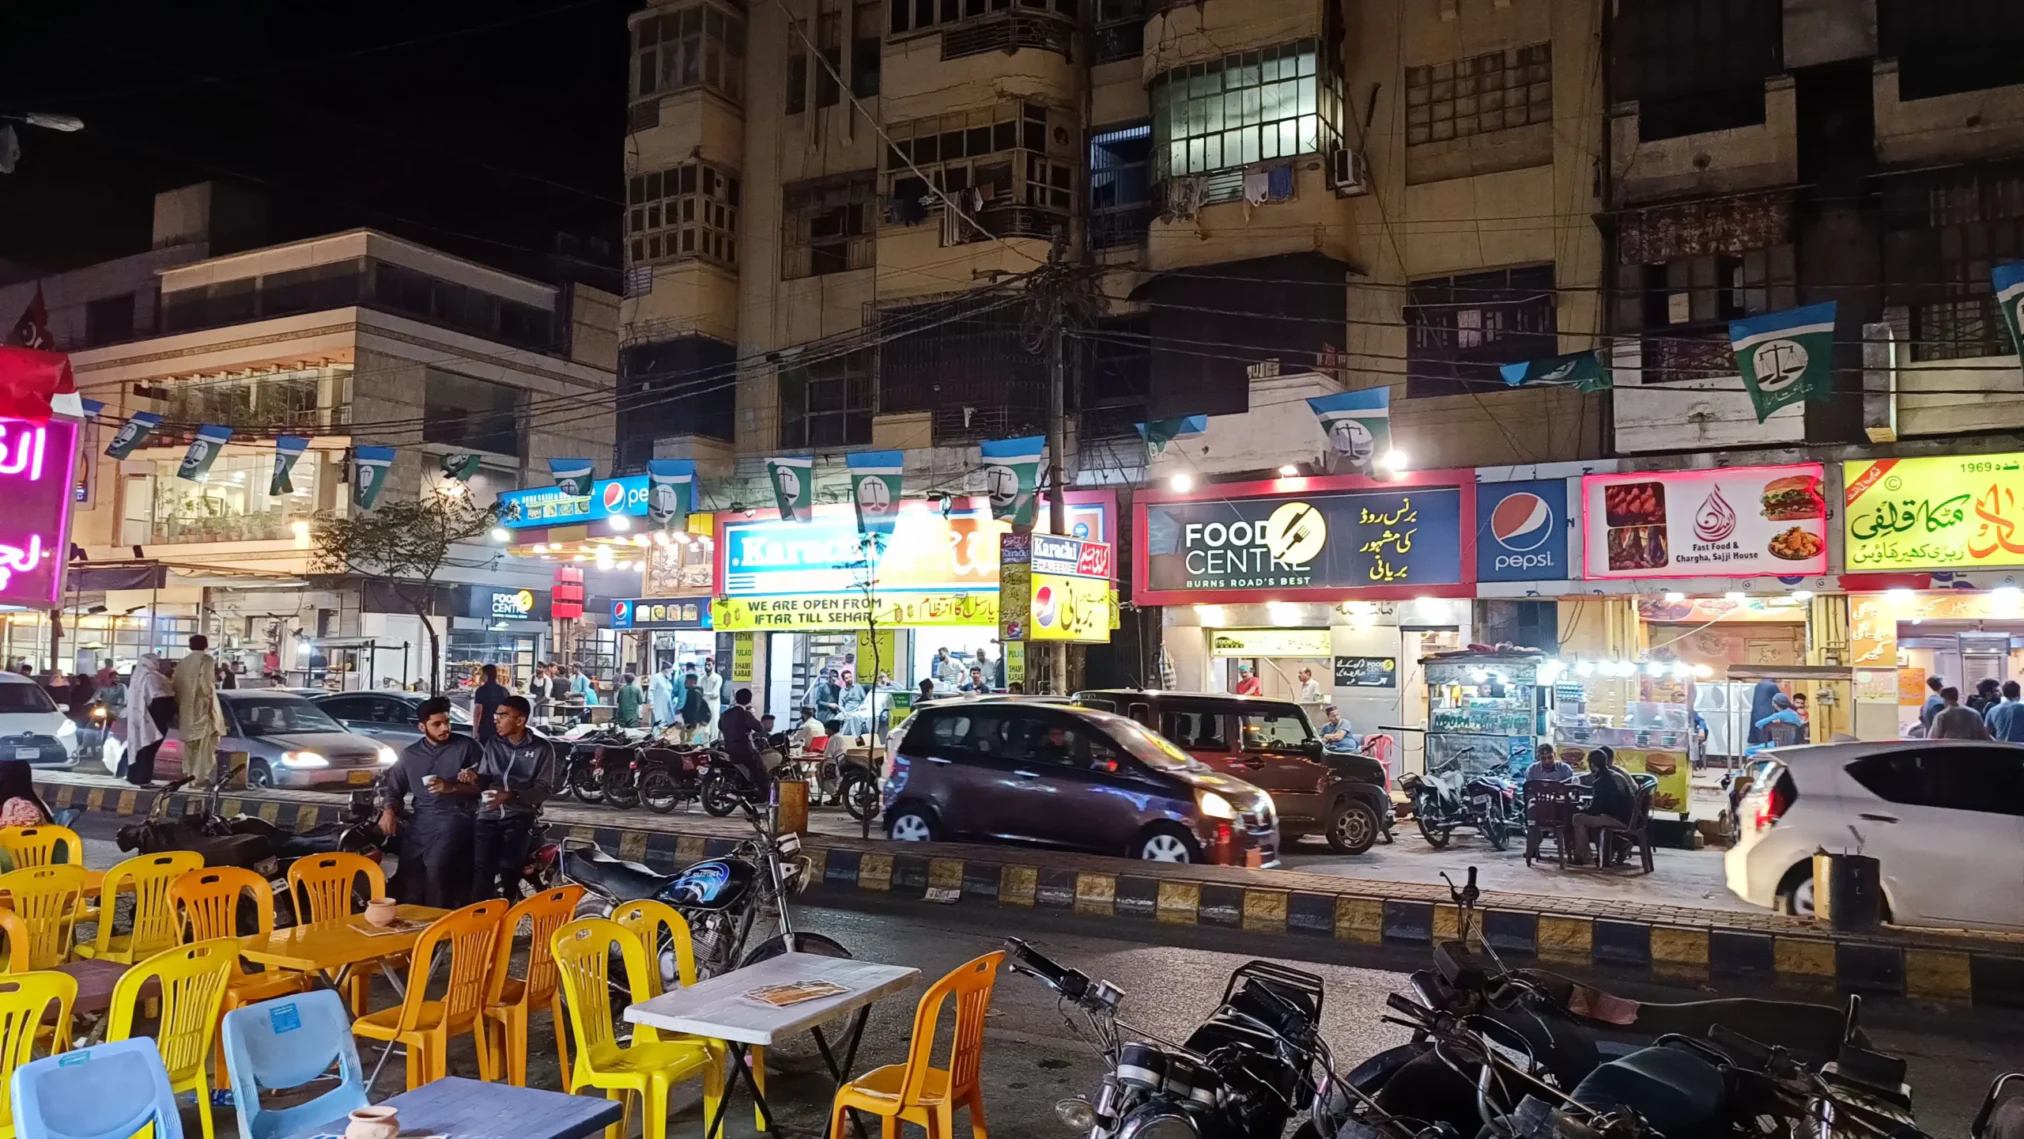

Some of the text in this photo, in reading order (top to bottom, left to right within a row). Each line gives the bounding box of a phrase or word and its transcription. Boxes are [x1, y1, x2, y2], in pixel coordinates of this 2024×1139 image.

[1960, 462, 1992, 473] 1969
[1359, 498, 1418, 525] برنس روڈ
[1185, 519, 1268, 548] FOOD
[1359, 527, 1418, 553] کی مشہور
[1034, 537, 1077, 561] Karachi
[1692, 541, 1740, 552] Fast Food &
[1495, 551, 1552, 571] pepsi
[1675, 551, 1759, 563] Chargha, Sajji House
[1038, 561, 1070, 572] HALEEM
[1369, 554, 1408, 581] بریانی
[1186, 577, 1312, 589] BURNS ROAD'S BEST
[748, 598, 882, 612] WE ARE OPEN FROM
[754, 612, 873, 625] IFTAR TILL SEHAR
